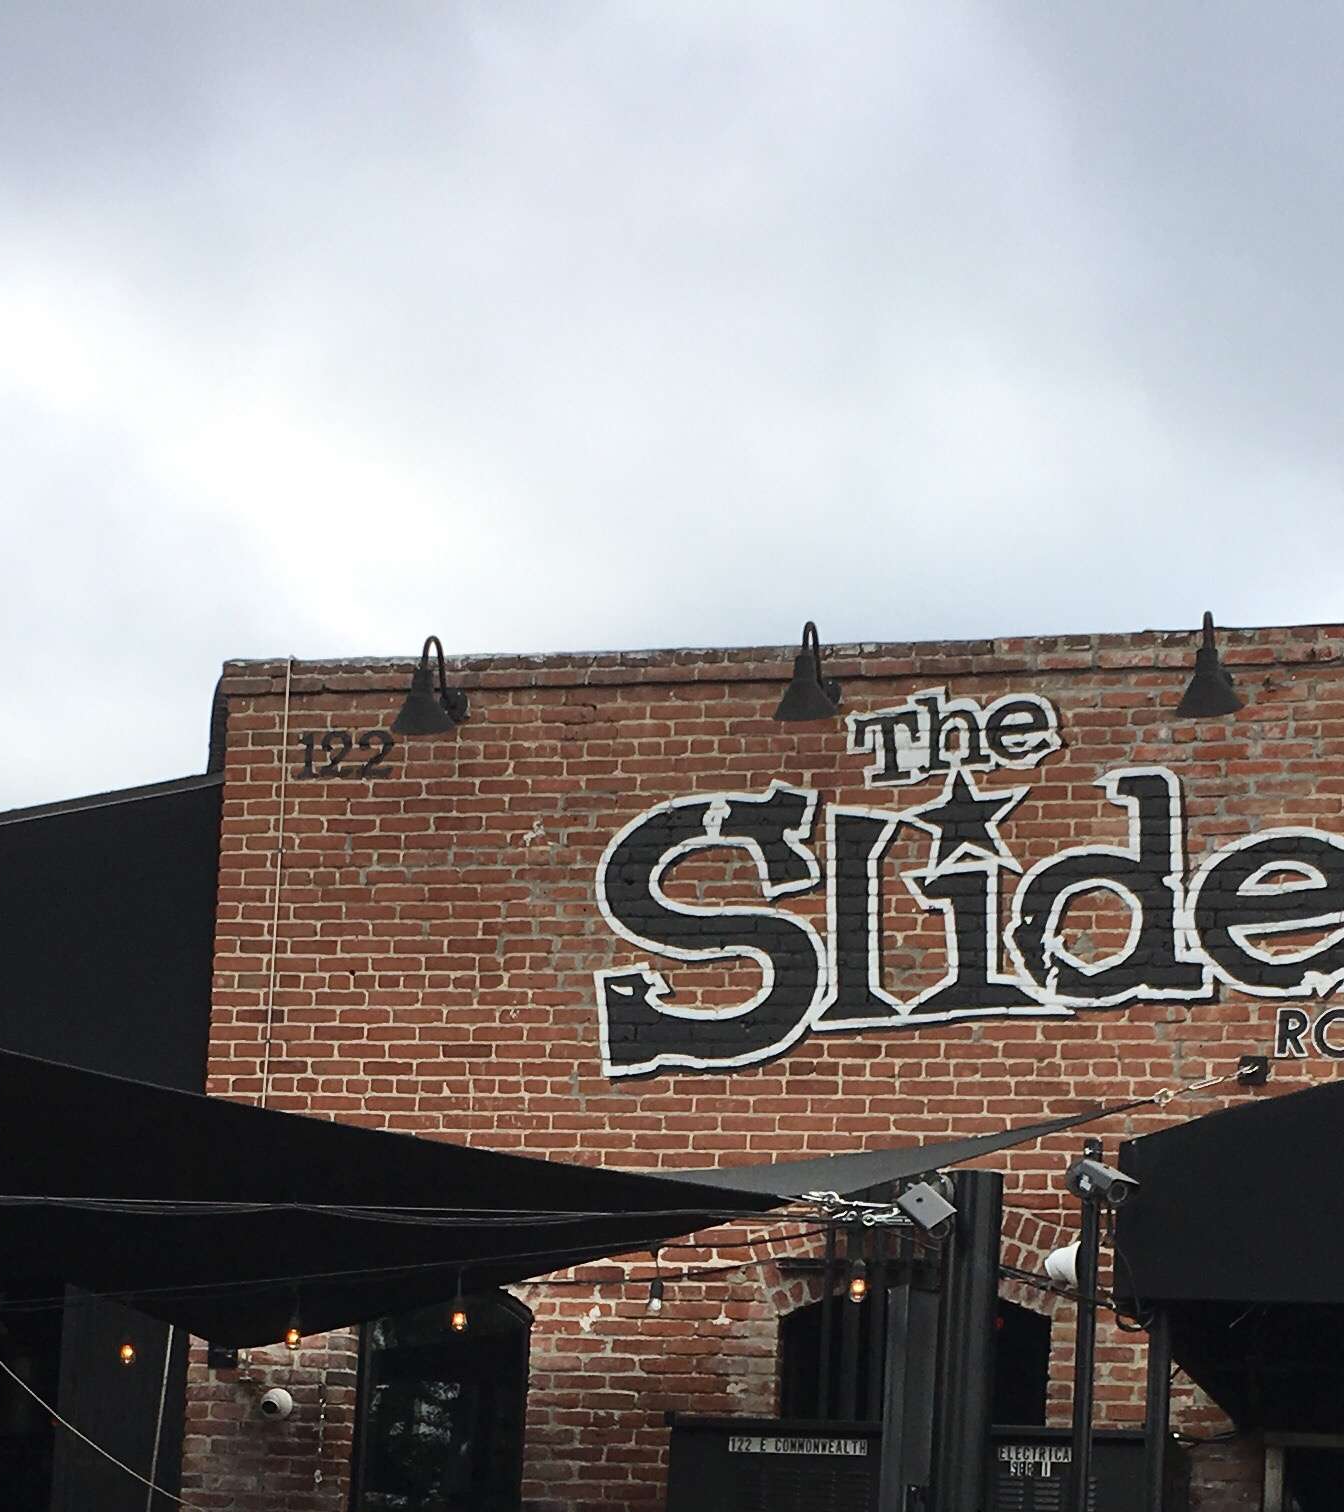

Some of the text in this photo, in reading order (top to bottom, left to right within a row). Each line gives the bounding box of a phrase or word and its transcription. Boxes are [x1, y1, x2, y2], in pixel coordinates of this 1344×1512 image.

[299, 729, 396, 780] 122
[845, 686, 1062, 790] The
[730, 1437, 868, 1456] 122 E COMMONWEALTH
